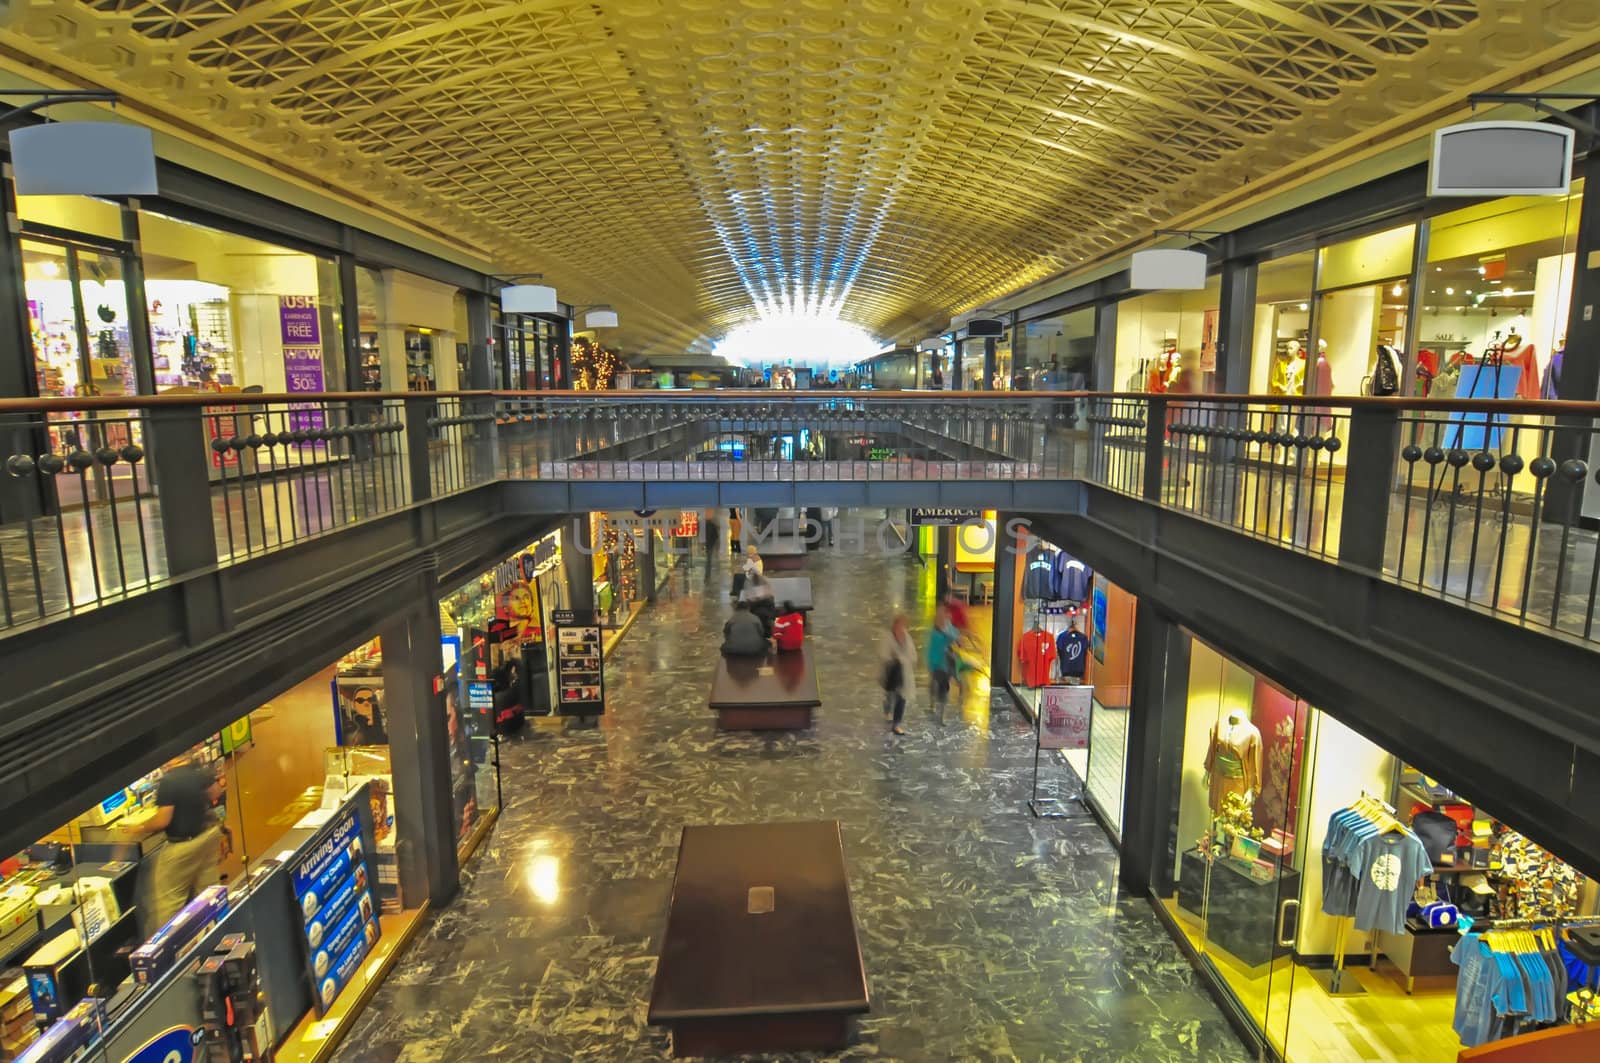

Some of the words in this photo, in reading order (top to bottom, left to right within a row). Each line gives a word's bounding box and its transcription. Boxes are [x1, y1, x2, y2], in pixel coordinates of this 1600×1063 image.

[287, 325, 312, 337] FREE
[284, 349, 320, 360] WOW
[675, 524, 698, 535] OFF
[300, 838, 333, 879] Arriving
[333, 816, 355, 843] Soon
